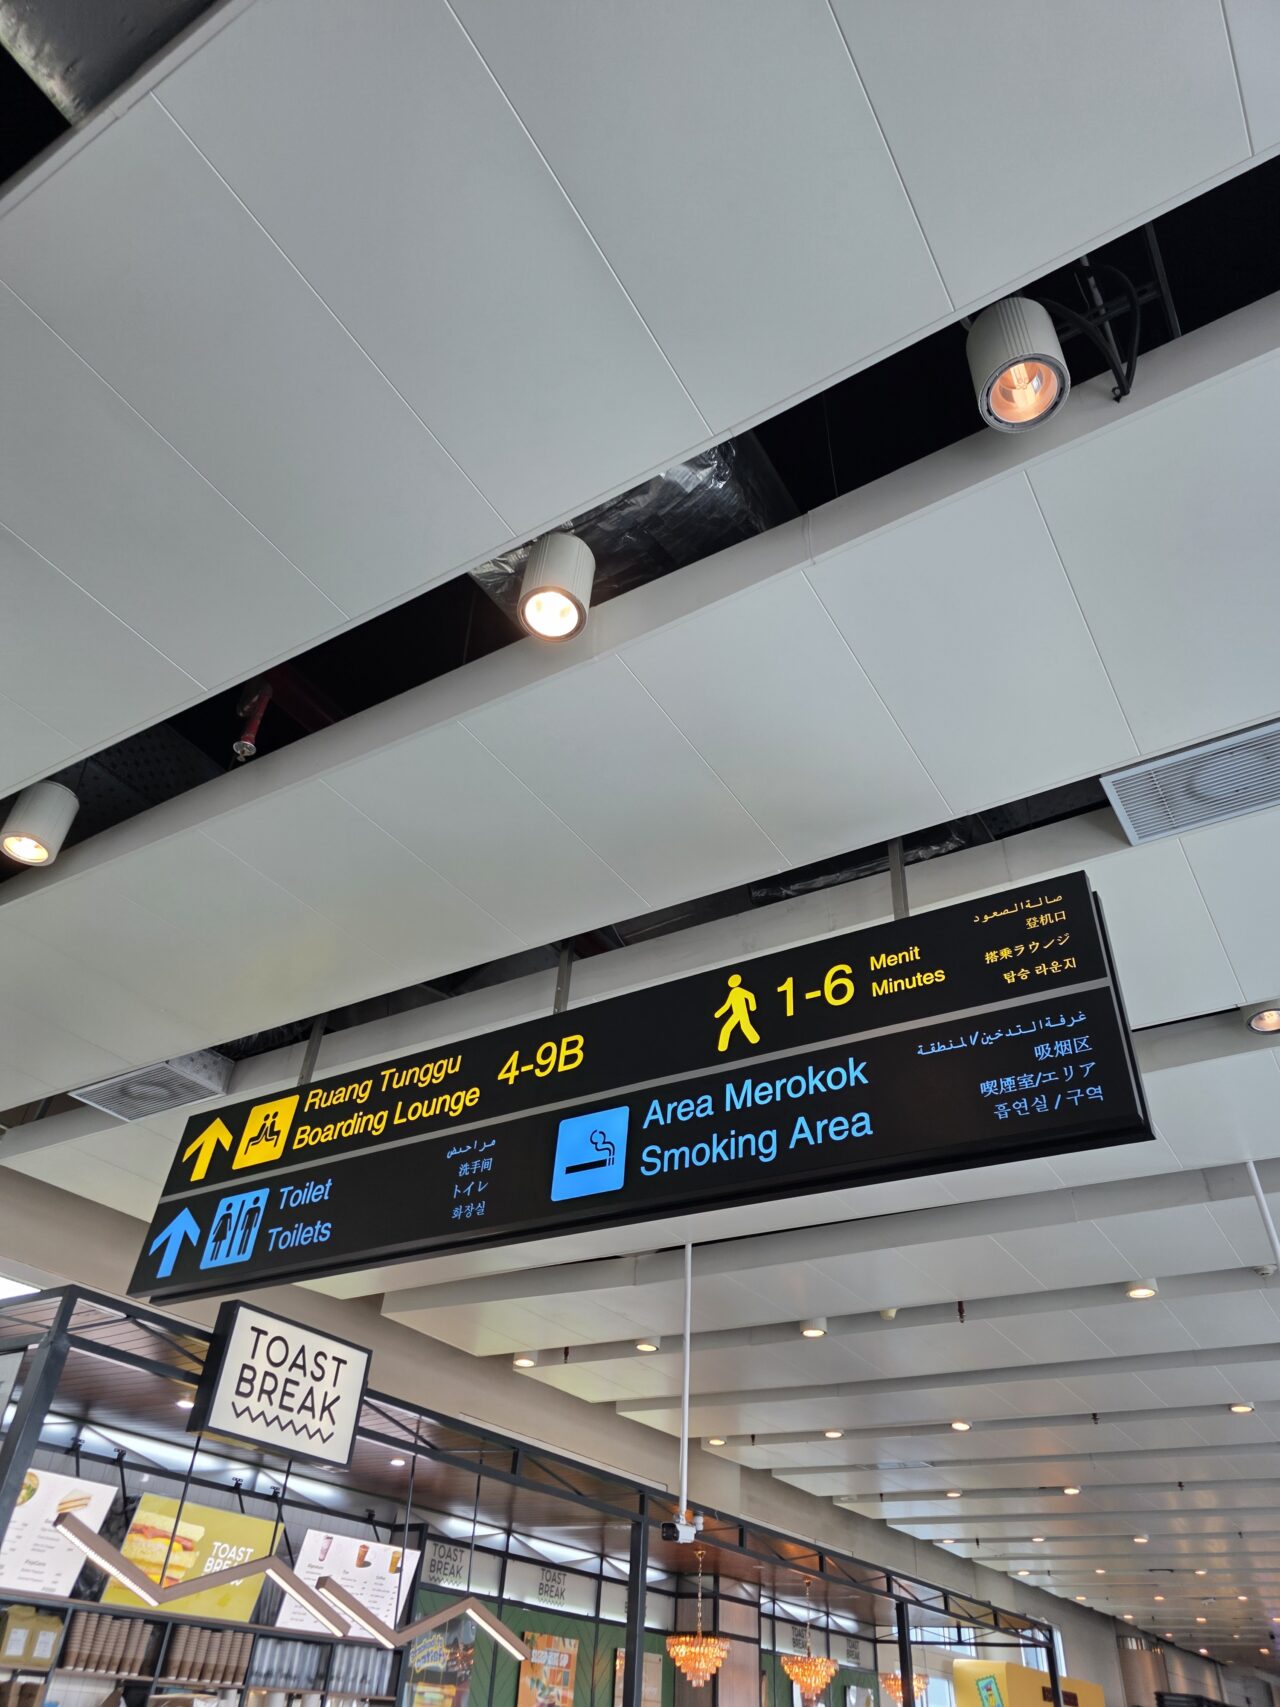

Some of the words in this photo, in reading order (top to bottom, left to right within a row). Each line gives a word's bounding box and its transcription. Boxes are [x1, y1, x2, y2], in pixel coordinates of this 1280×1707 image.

[1025, 910, 1067, 929] 登机口
[869, 946, 921, 972] Menit
[1003, 968, 1031, 984] 탑승
[1035, 957, 1077, 976] 라운지
[777, 963, 855, 1017] 1-6
[872, 968, 946, 998] Minutes
[497, 1034, 585, 1086] 4-9B
[1034, 1036, 1093, 1061] 吸烟区
[304, 1078, 374, 1112] Ruang
[380, 1055, 462, 1092] Tunggu
[980, 1062, 1097, 1098] 喫煙室/エリア
[642, 1094, 715, 1130] Area
[725, 1057, 869, 1112] Merokok
[1066, 1085, 1104, 1106] 구역
[293, 1107, 388, 1150] Boarding
[394, 1086, 481, 1125] Lounge
[639, 1129, 778, 1177] Smoking
[788, 1111, 874, 1150] Area
[459, 1158, 493, 1177] 洗手间
[279, 1178, 333, 1210] Toilet
[453, 1181, 489, 1199] トイレ
[451, 1201, 486, 1220] 화장실
[267, 1220, 332, 1252] Toilets
[249, 1325, 348, 1388] TOAST
[234, 1363, 342, 1426] BREAK
[202, 1557, 239, 1573] BRE
[212, 1541, 254, 1563] TOAST
[432, 1542, 465, 1563] TOAST
[429, 1559, 464, 1579] BREAK
[541, 1567, 567, 1586] TOAST
[538, 1582, 566, 1601] BREAK
